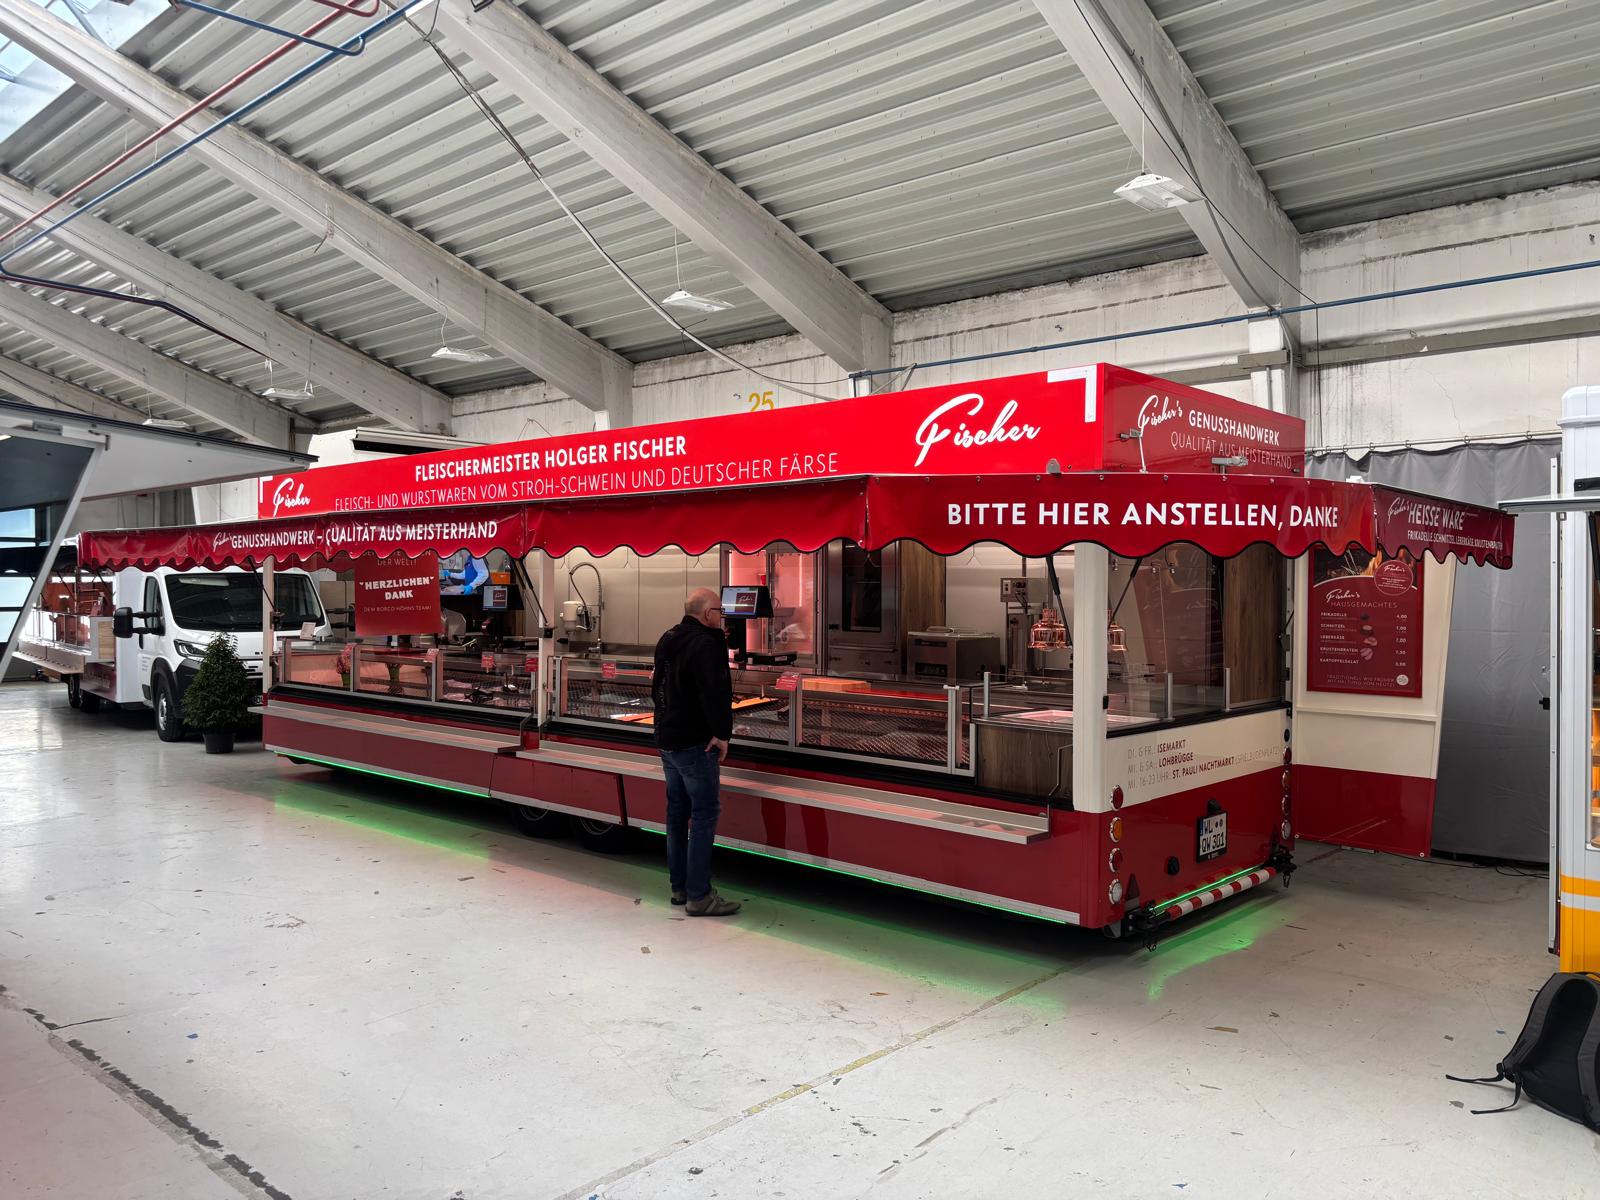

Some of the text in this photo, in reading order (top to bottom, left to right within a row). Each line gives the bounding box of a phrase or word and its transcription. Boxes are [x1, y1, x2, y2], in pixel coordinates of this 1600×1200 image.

[748, 391, 775, 412] 25
[914, 393, 1041, 467] Fischer
[1137, 394, 1280, 447] Fischer's GENUSSHANDWERK
[415, 435, 687, 482] FLEISCHERMEISTER HOLGER FISCHER
[1170, 431, 1292, 470] QUALITÄT AUS MEISTERHAND
[335, 452, 839, 512] FLEISCH- UND WURSTWAREN VOM STROH-SCHWEIN UND DEUTSCHER FÄRSE
[273, 478, 310, 517] Fischer
[947, 502, 1338, 531] BITTE HIER ANSTELLEN, DANKE
[1408, 502, 1440, 527] HEISSE
[1442, 507, 1465, 531] WARE
[232, 529, 315, 549] GENUSSHANDWERK
[379, 523, 402, 541] AUS
[405, 520, 498, 541] MEISTERHAND
[385, 590, 413, 600] DANK
[1157, 739, 1186, 754] ISEMARKT
[1158, 751, 1194, 768] LOHBRÜGGE
[1172, 769, 1181, 779] ST.
[1182, 765, 1198, 777] PAULI
[1199, 756, 1235, 774] NACHTMARKT
[1212, 832, 1225, 850] 301
